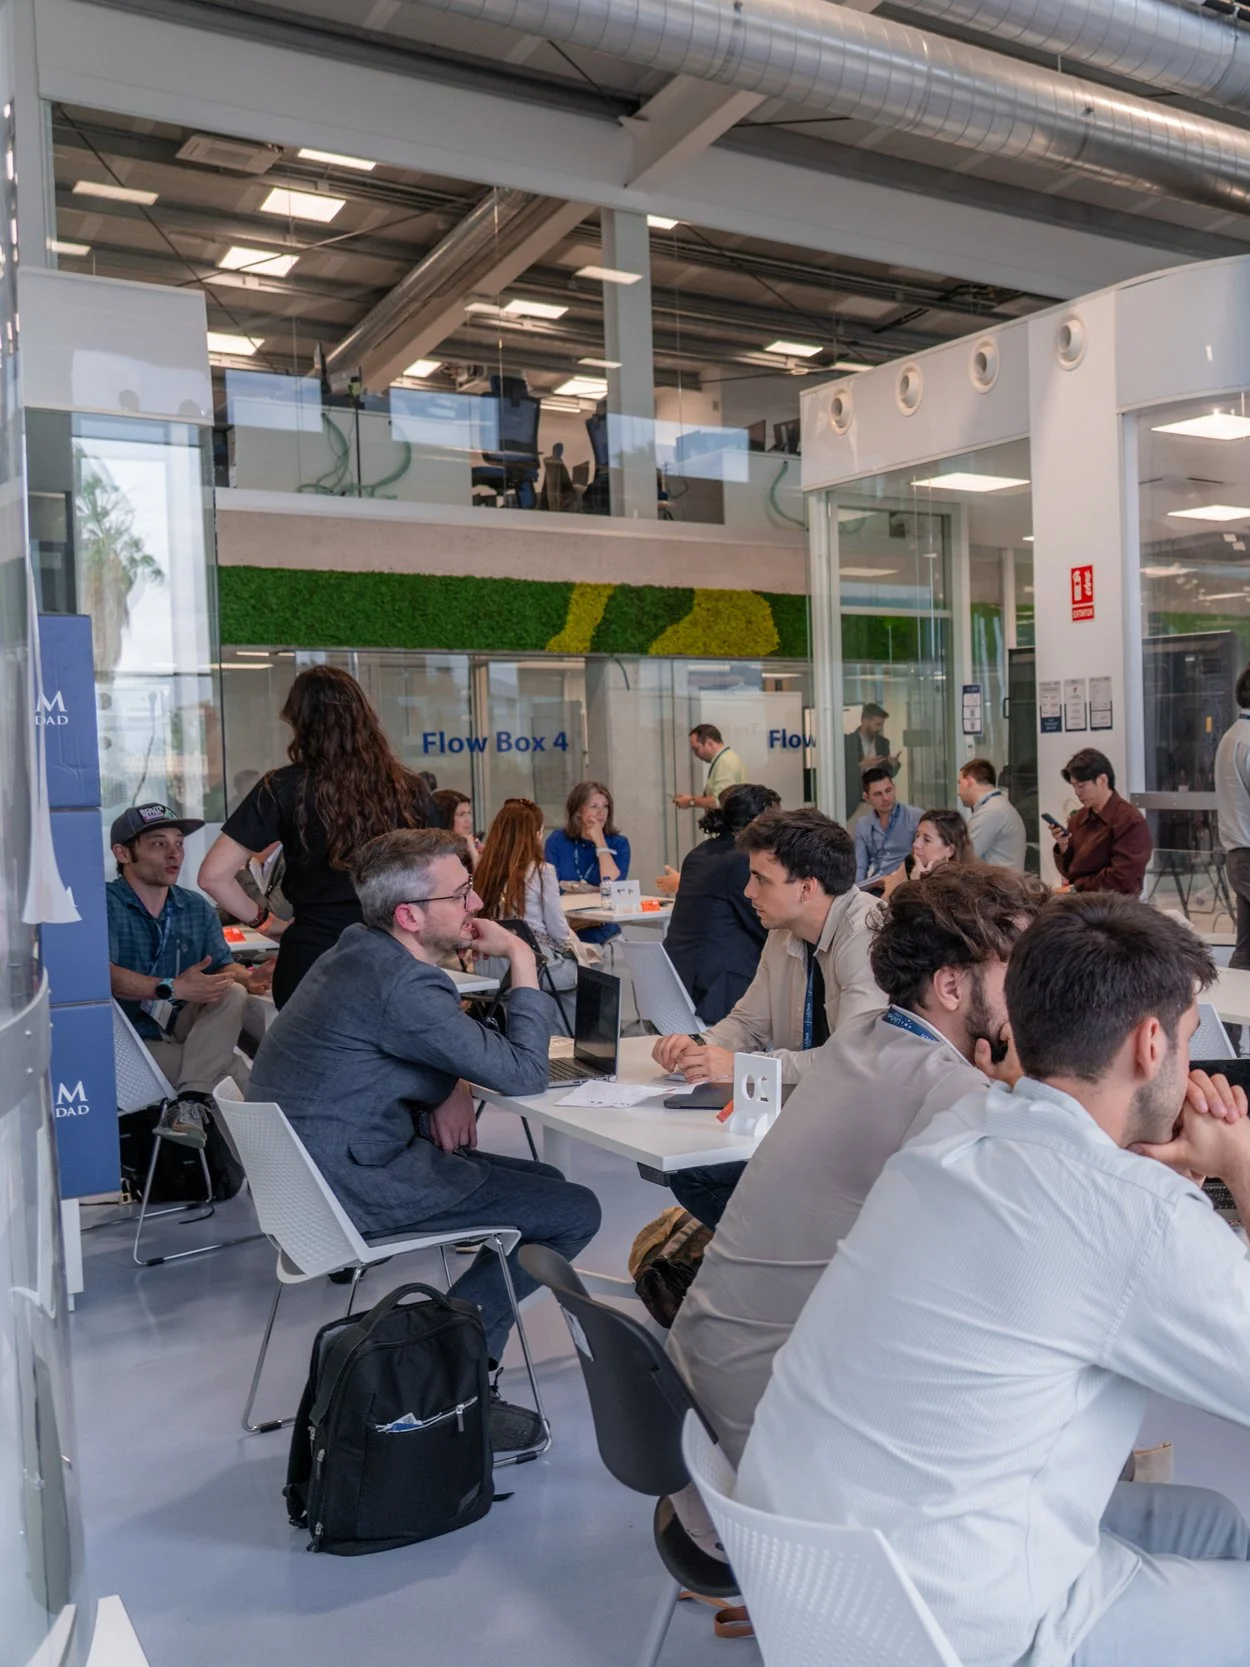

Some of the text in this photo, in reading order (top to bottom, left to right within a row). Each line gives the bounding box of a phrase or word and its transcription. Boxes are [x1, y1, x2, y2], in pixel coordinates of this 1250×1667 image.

[422, 731, 568, 753] Flow Box 4
[55, 1104, 90, 1118] DAD
